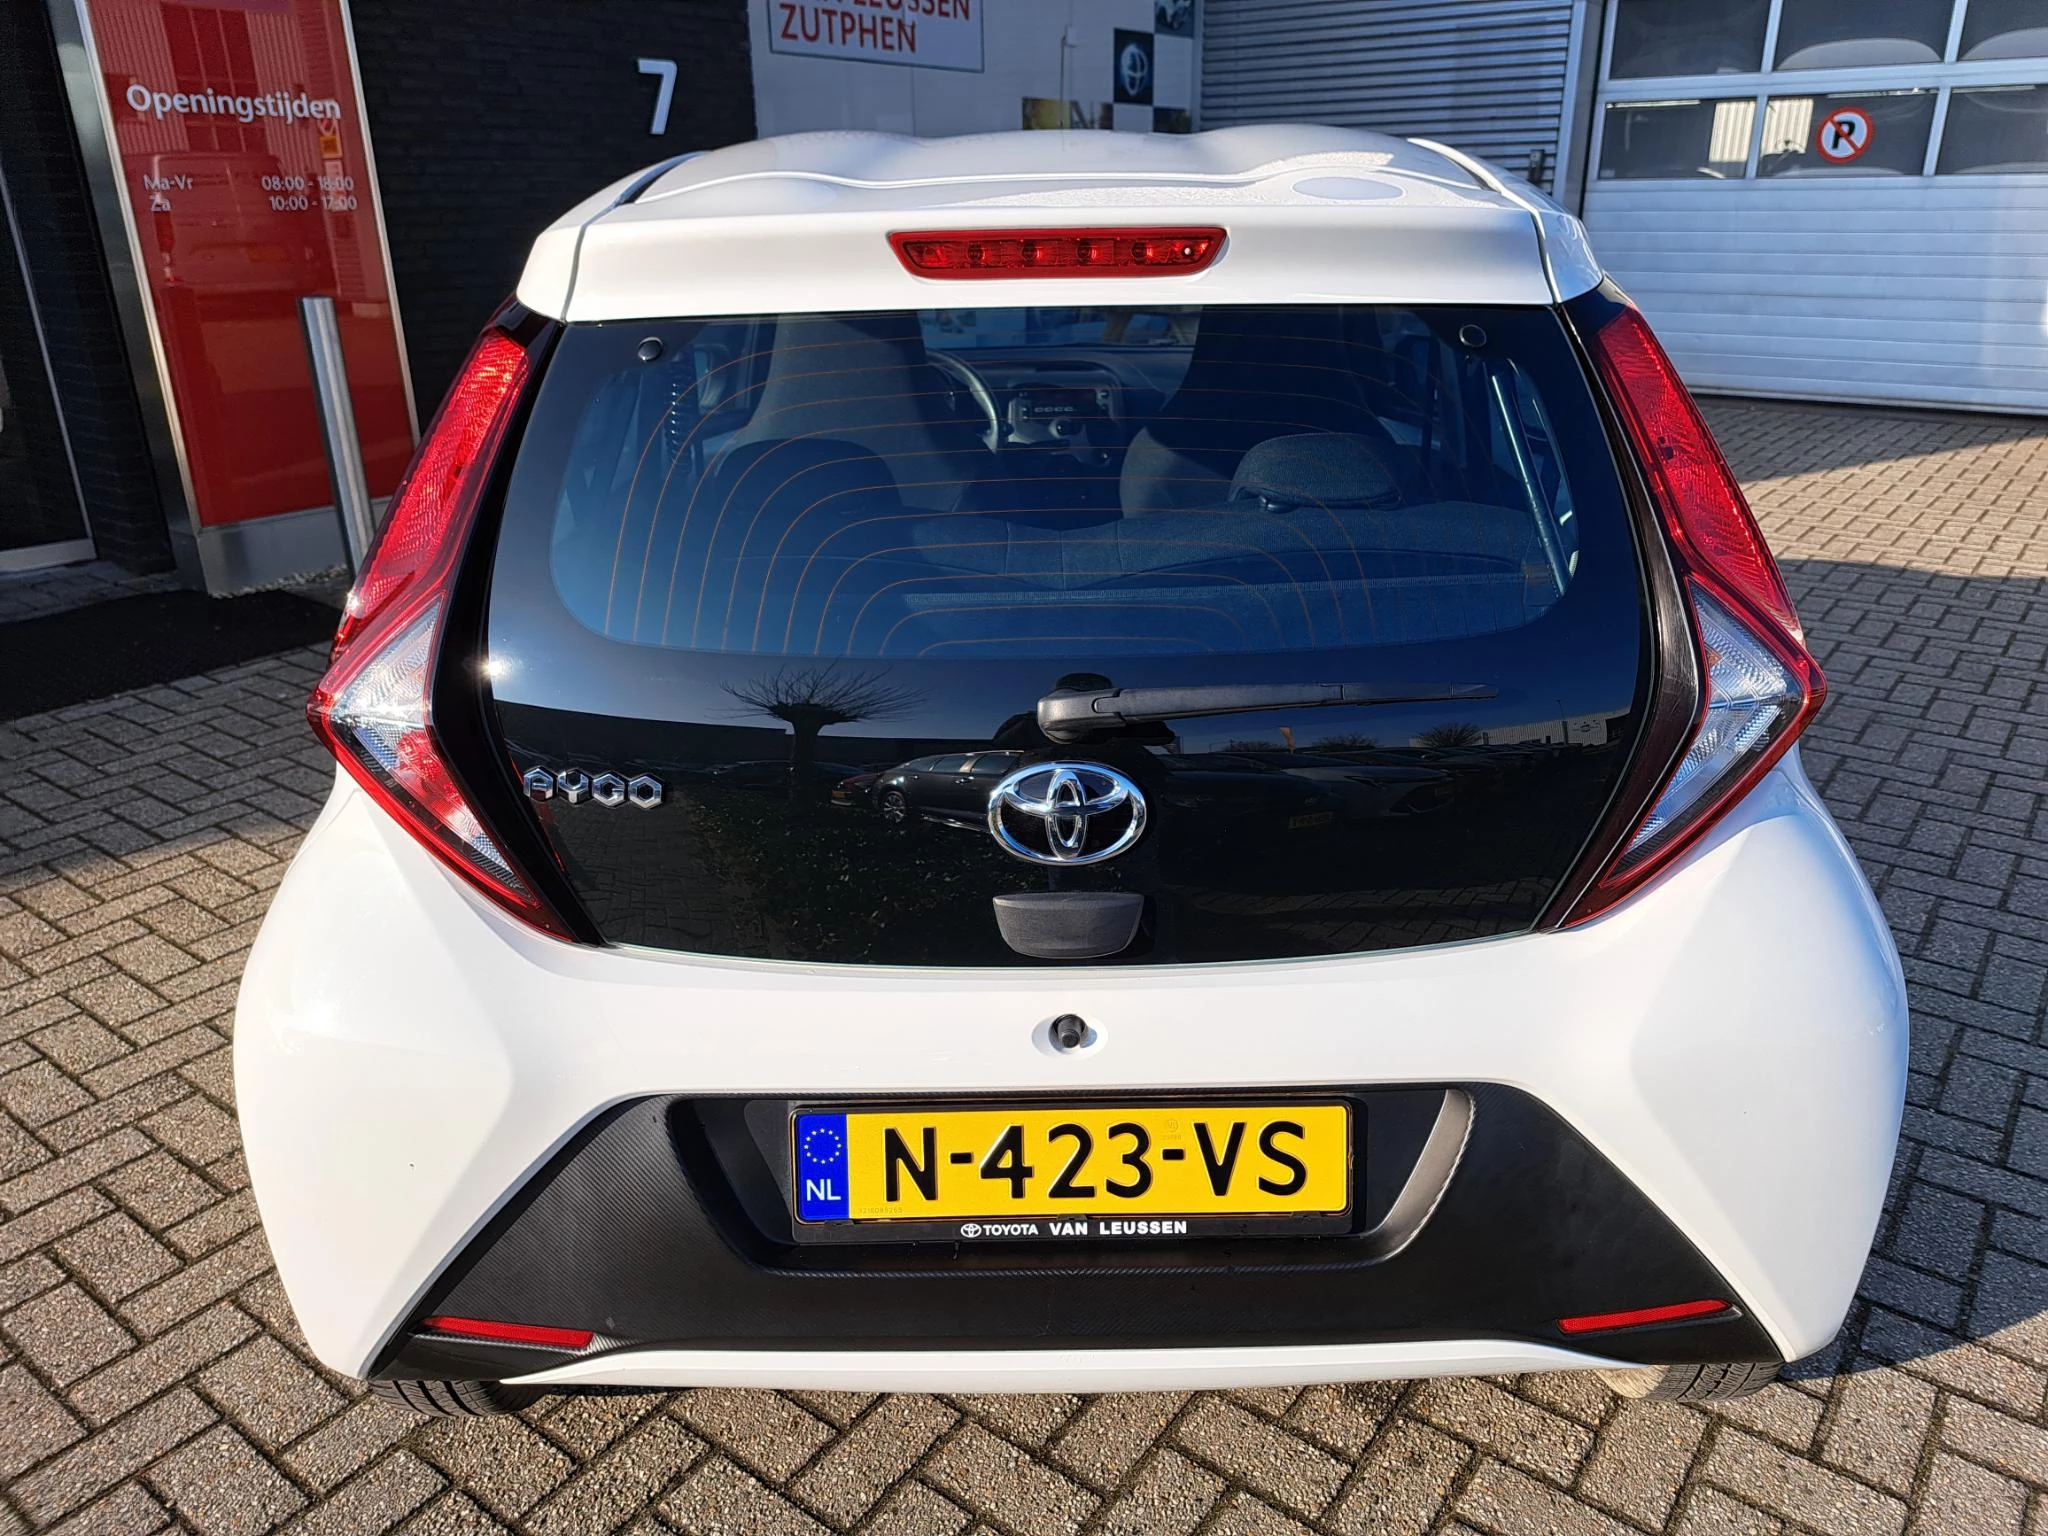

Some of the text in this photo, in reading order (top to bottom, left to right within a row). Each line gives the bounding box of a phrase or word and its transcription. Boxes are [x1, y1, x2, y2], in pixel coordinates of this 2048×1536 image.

[779, 3, 917, 54] ZUTPHEN
[126, 83, 342, 125] Openingstijden
[637, 58, 678, 135] 7
[1832, 120, 1856, 150] P
[261, 176, 305, 191] 08:00
[150, 195, 172, 212] Za
[270, 195, 309, 211] 10:00
[523, 767, 663, 810] AYGO
[883, 1120, 1308, 1201] N-423-VS
[806, 1178, 842, 1201] NL
[983, 1221, 1187, 1236] TOYOTA VAN LEUSSEN
